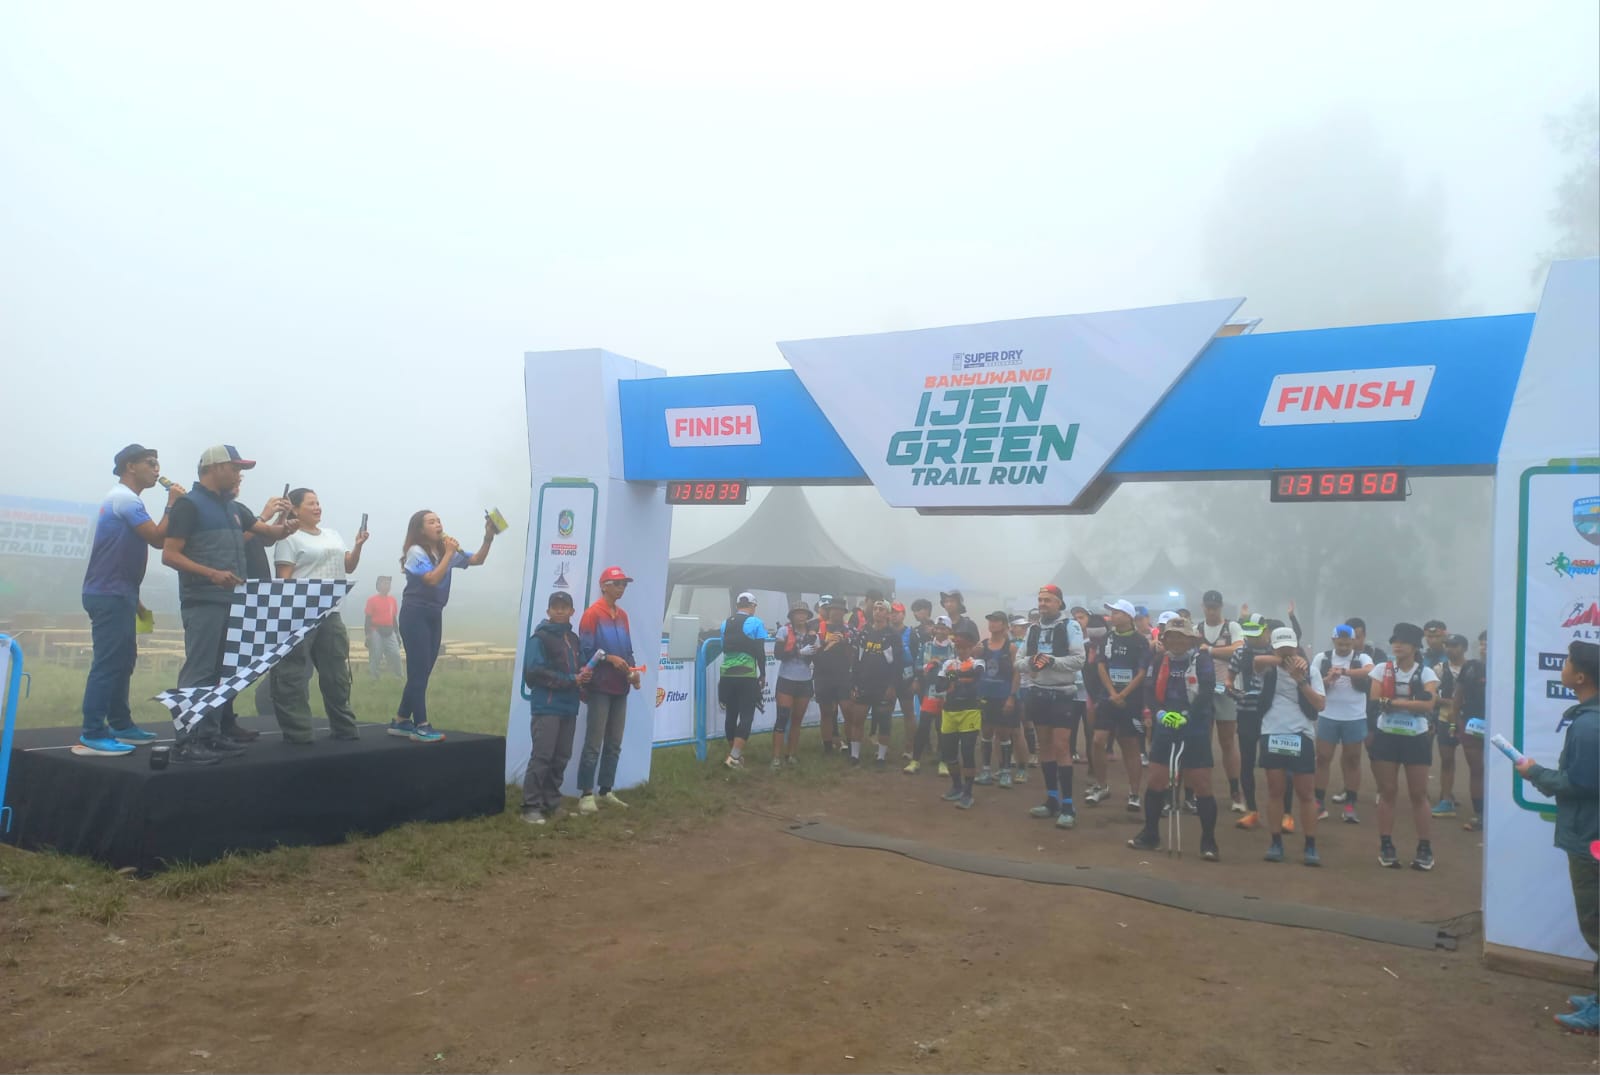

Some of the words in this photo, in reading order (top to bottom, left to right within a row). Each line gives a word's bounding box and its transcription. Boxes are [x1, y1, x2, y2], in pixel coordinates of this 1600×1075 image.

[964, 352, 999, 363] SUPER
[1001, 349, 1024, 361] DRY
[924, 368, 1052, 389] BANYUWANGI
[914, 385, 1048, 427] IJEN
[1277, 380, 1415, 413] FINISH
[675, 415, 752, 438] FINISH
[886, 423, 1080, 466] GREEN
[911, 467, 981, 486] TRAIL
[989, 466, 1048, 485] RUN
[1282, 475, 1313, 495] 13
[1320, 474, 1354, 496] 59
[1362, 472, 1398, 494] 50
[675, 483, 692, 500] 13
[695, 482, 716, 500] 58
[719, 483, 740, 500] 39
[52, 544, 88, 558] RUN
[1545, 657, 1566, 668] UT
[666, 690, 688, 702] Fitbar
[1550, 683, 1576, 697] iTR
